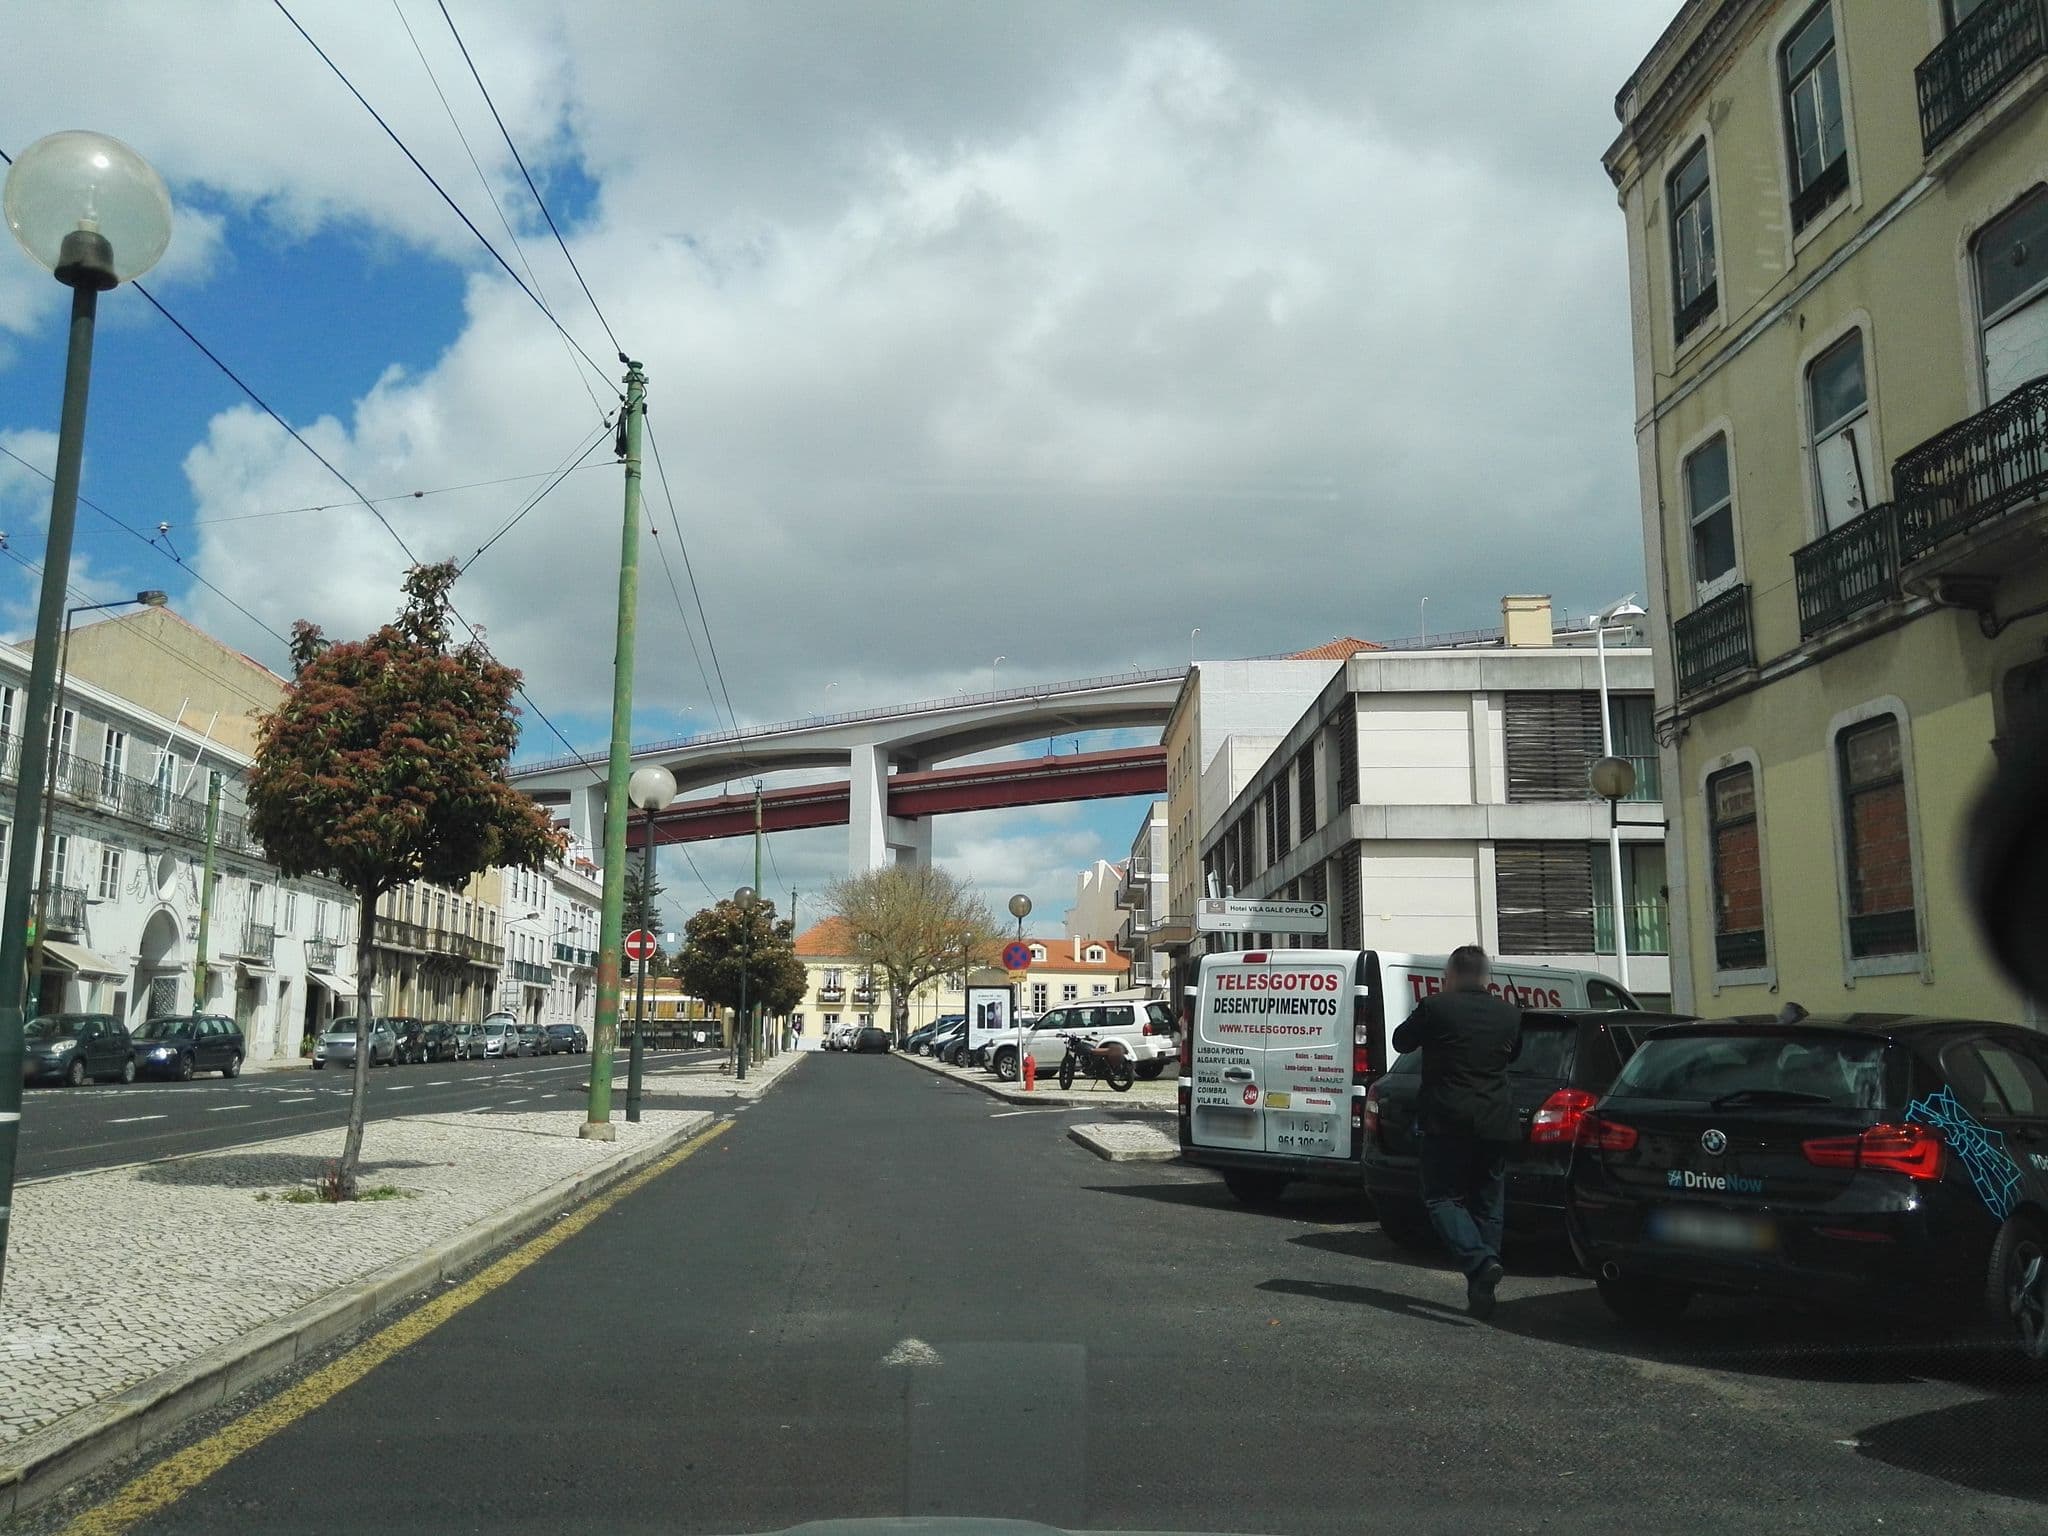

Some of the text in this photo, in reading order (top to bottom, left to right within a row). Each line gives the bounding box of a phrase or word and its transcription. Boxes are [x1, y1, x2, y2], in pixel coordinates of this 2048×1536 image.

[1248, 905, 1264, 913] VILA
[1216, 974, 1338, 991] TELESGOTOS
[1214, 998, 1337, 1016] DESENTUPIMENTOS
[1219, 1024, 1323, 1036] WWW.TELESGOTOS.PT
[1197, 1047, 1220, 1055] LISBOA
[1196, 1056, 1226, 1065] ALGARVE
[1198, 1076, 1220, 1084] BRAGA
[1197, 1086, 1227, 1094] COIMBRA
[1244, 1089, 1258, 1101] 24H
[1212, 1097, 1230, 1105] REAL
[1684, 1170, 1763, 1193] DriveNow
